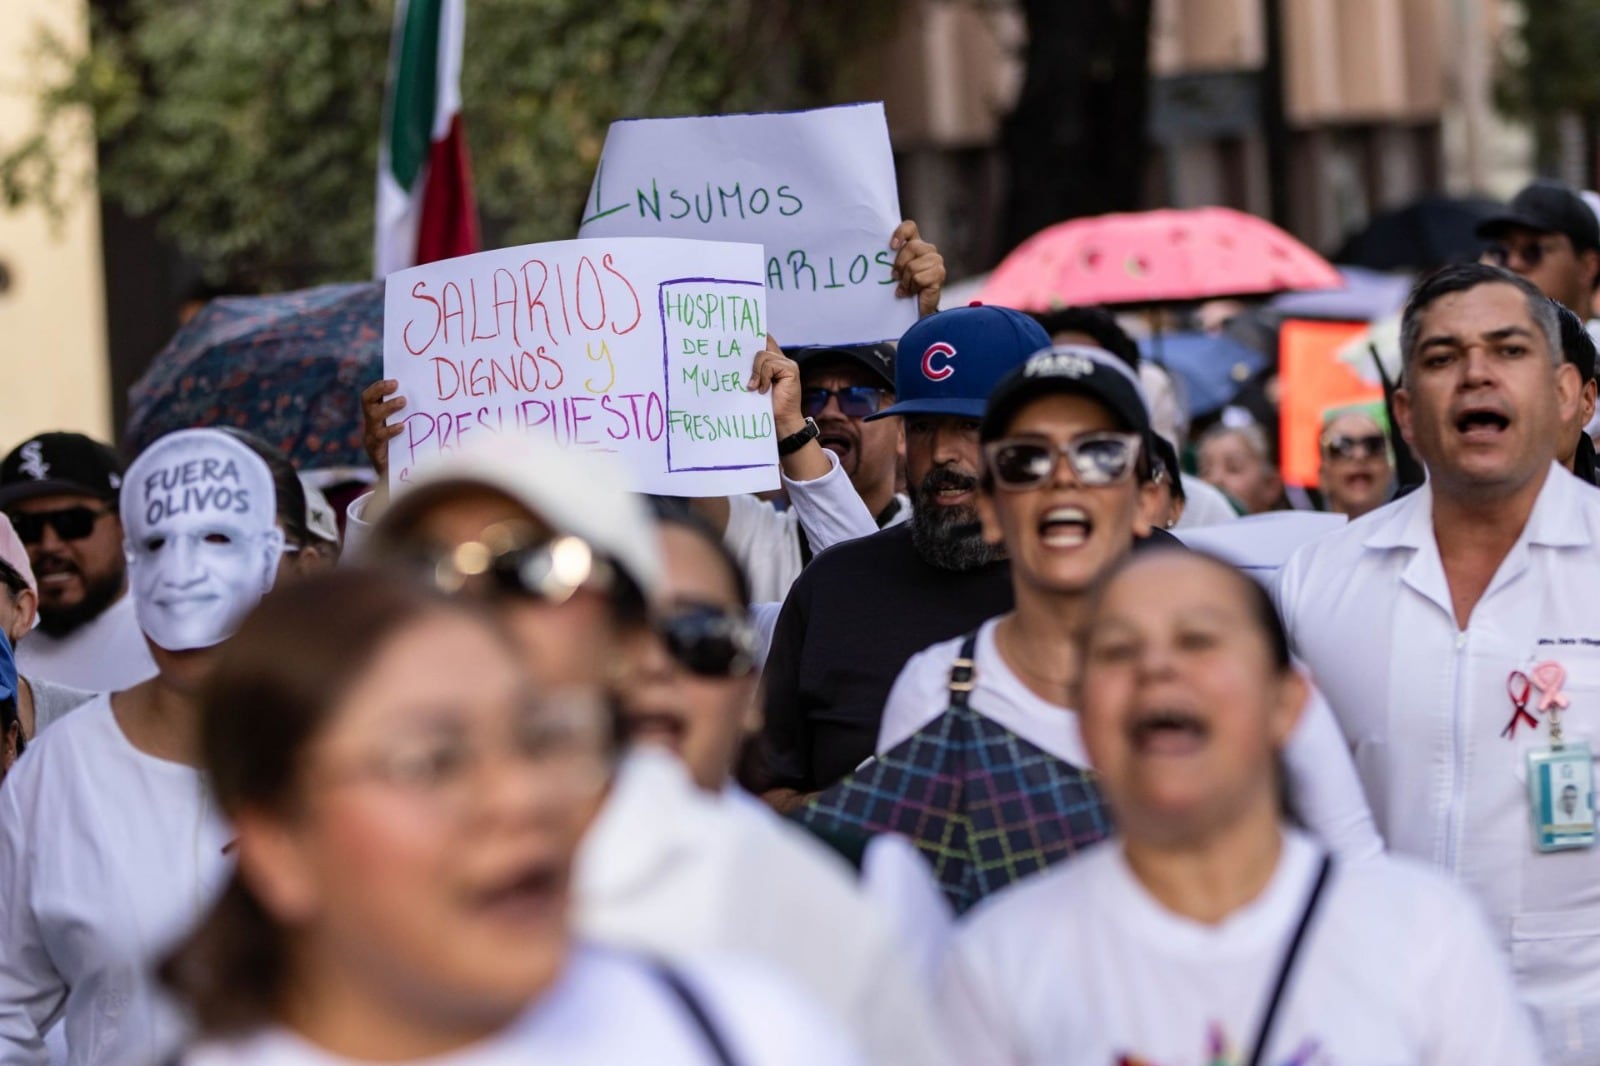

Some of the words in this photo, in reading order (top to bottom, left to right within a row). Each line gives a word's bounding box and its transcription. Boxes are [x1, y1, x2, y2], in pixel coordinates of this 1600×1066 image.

[580, 158, 804, 225] INSUMOS
[766, 249, 898, 292] ARIOS
[403, 252, 642, 356] SALARIOS
[666, 289, 767, 338] HOSPITAL
[682, 338, 708, 356] DE
[717, 339, 742, 358] LA
[921, 341, 957, 382] C
[429, 345, 564, 401] DIGNOS
[682, 363, 750, 398] MUJER
[668, 409, 773, 442] FRESNILLO
[143, 457, 241, 499] FUERA
[145, 487, 251, 526] OLIVOS
